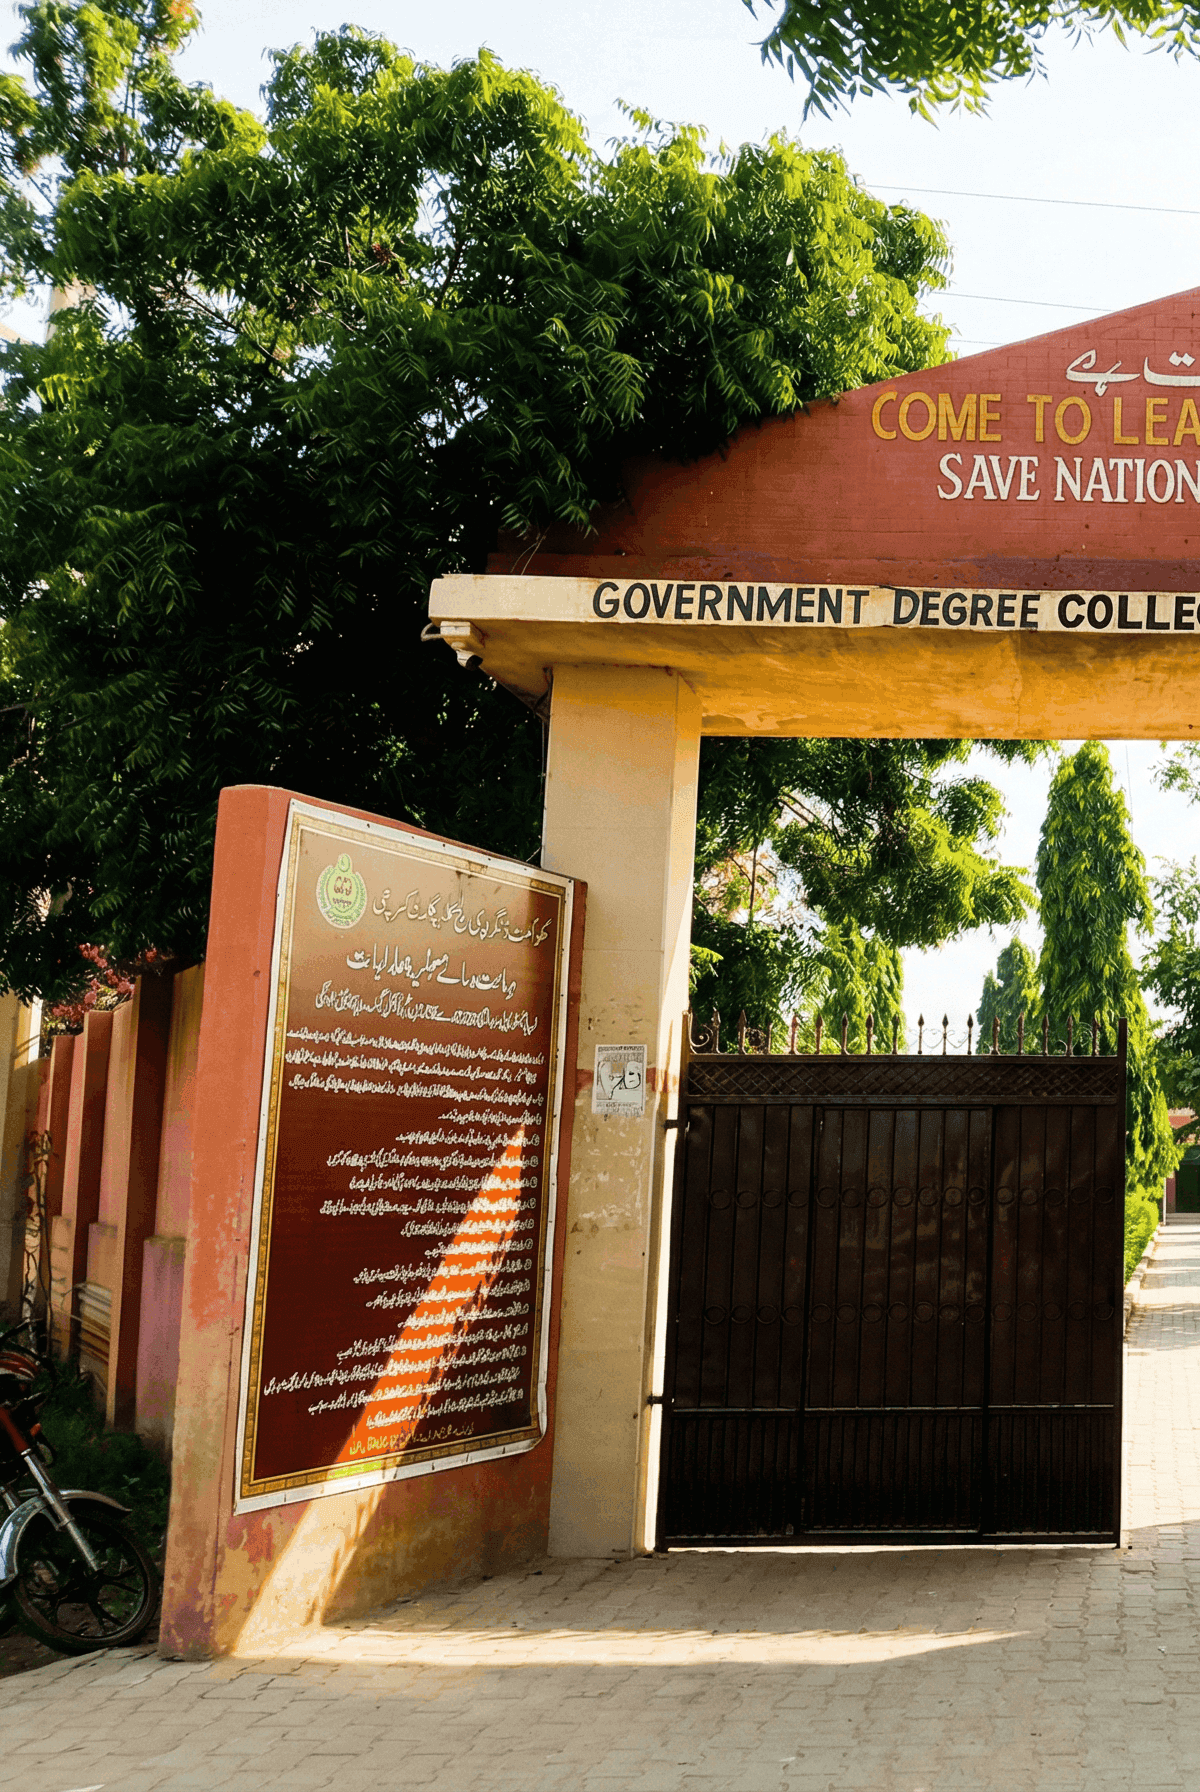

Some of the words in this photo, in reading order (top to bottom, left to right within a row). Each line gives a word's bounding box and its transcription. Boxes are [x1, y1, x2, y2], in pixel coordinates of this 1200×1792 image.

[871, 391, 1002, 443] COME
[1026, 394, 1092, 445] TO
[937, 453, 1040, 501] SAVE
[592, 582, 870, 625] GOVERNMENT
[892, 588, 1041, 628] DEGREE
